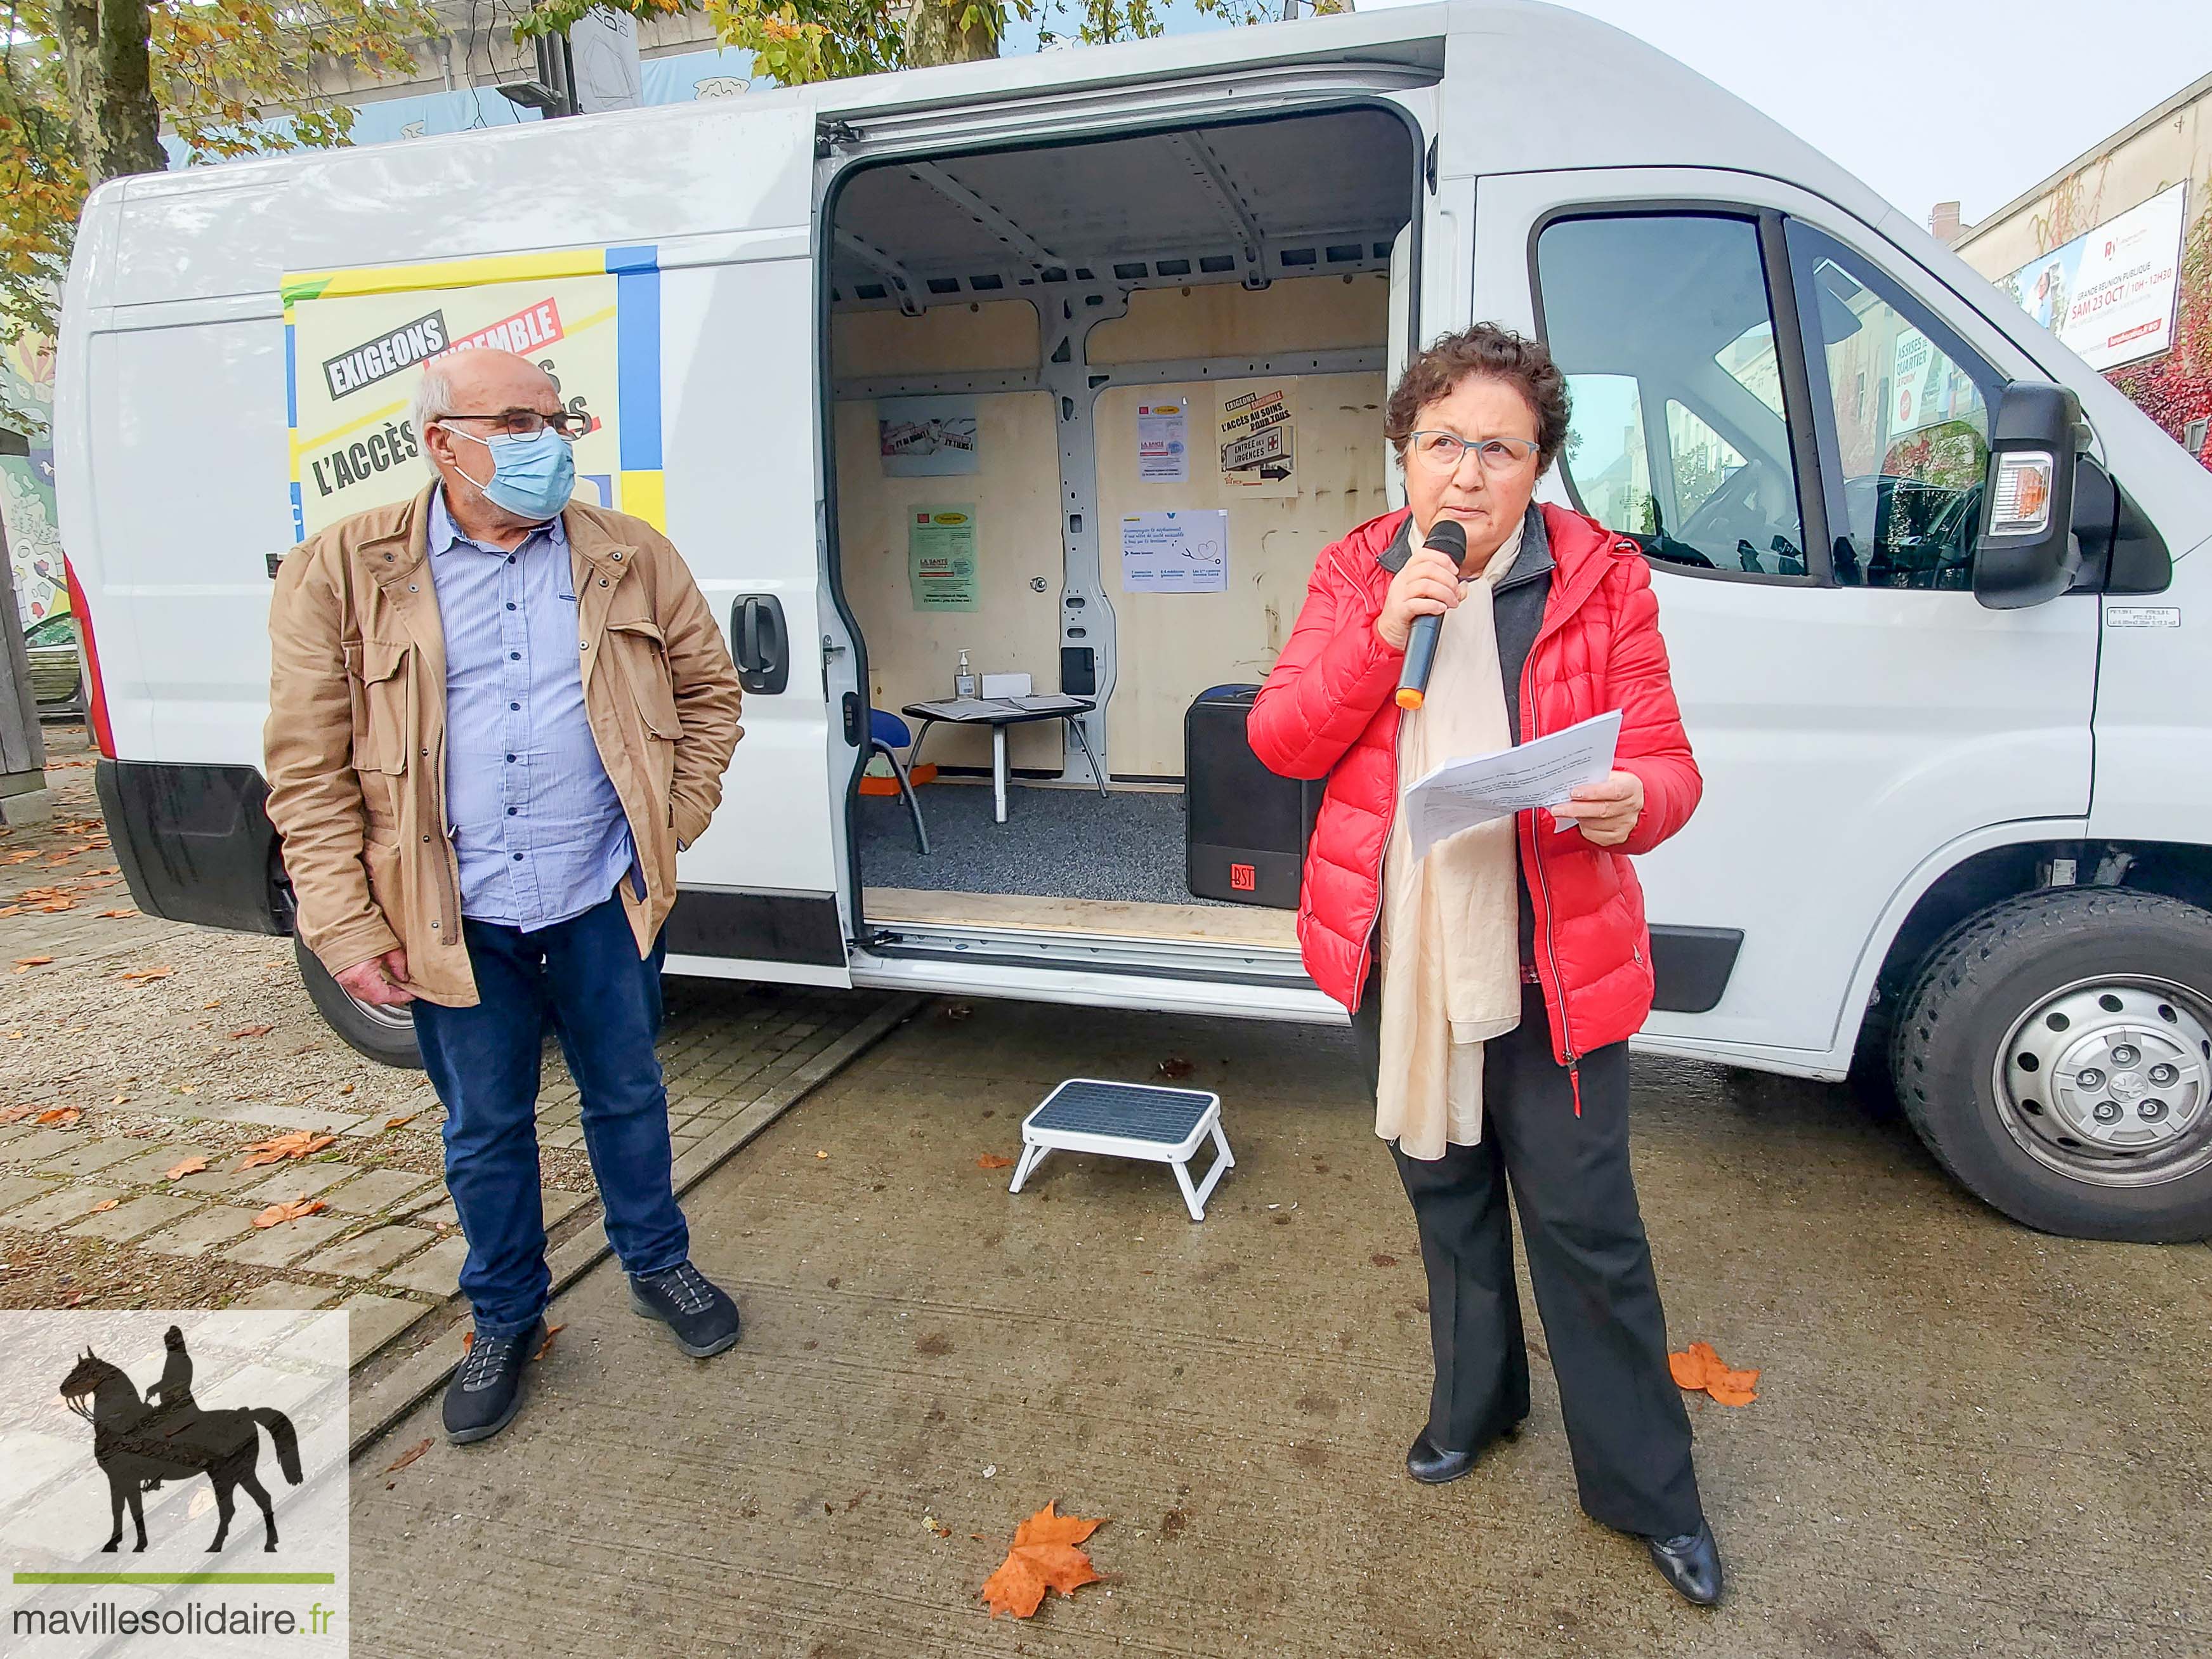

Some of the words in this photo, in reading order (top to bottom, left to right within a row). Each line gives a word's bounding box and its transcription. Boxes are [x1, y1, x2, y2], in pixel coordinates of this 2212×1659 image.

[2072, 299, 2091, 320] SAM
[2092, 295, 2104, 311] 23
[2105, 285, 2125, 306] OCT
[2131, 279, 2144, 293] 10H
[2149, 267, 2172, 284] 12H30
[327, 318, 444, 397] EXIGEONS
[428, 305, 556, 366] MBLE
[1898, 337, 1921, 360] ASSISES
[1897, 350, 1927, 376] QUARTIER
[1227, 394, 1256, 411] EXIGEONS
[1221, 414, 1250, 433] L'ACCÈS
[1250, 410, 1260, 423] AU
[1260, 402, 1283, 417] SOINS
[1250, 419, 1269, 431] POUR
[1269, 410, 1291, 423] TOUS
[312, 420, 418, 497] L'ACCÈS
[1234, 440, 1255, 454] ENTRÉE
[1234, 447, 1265, 463] URGENCES
